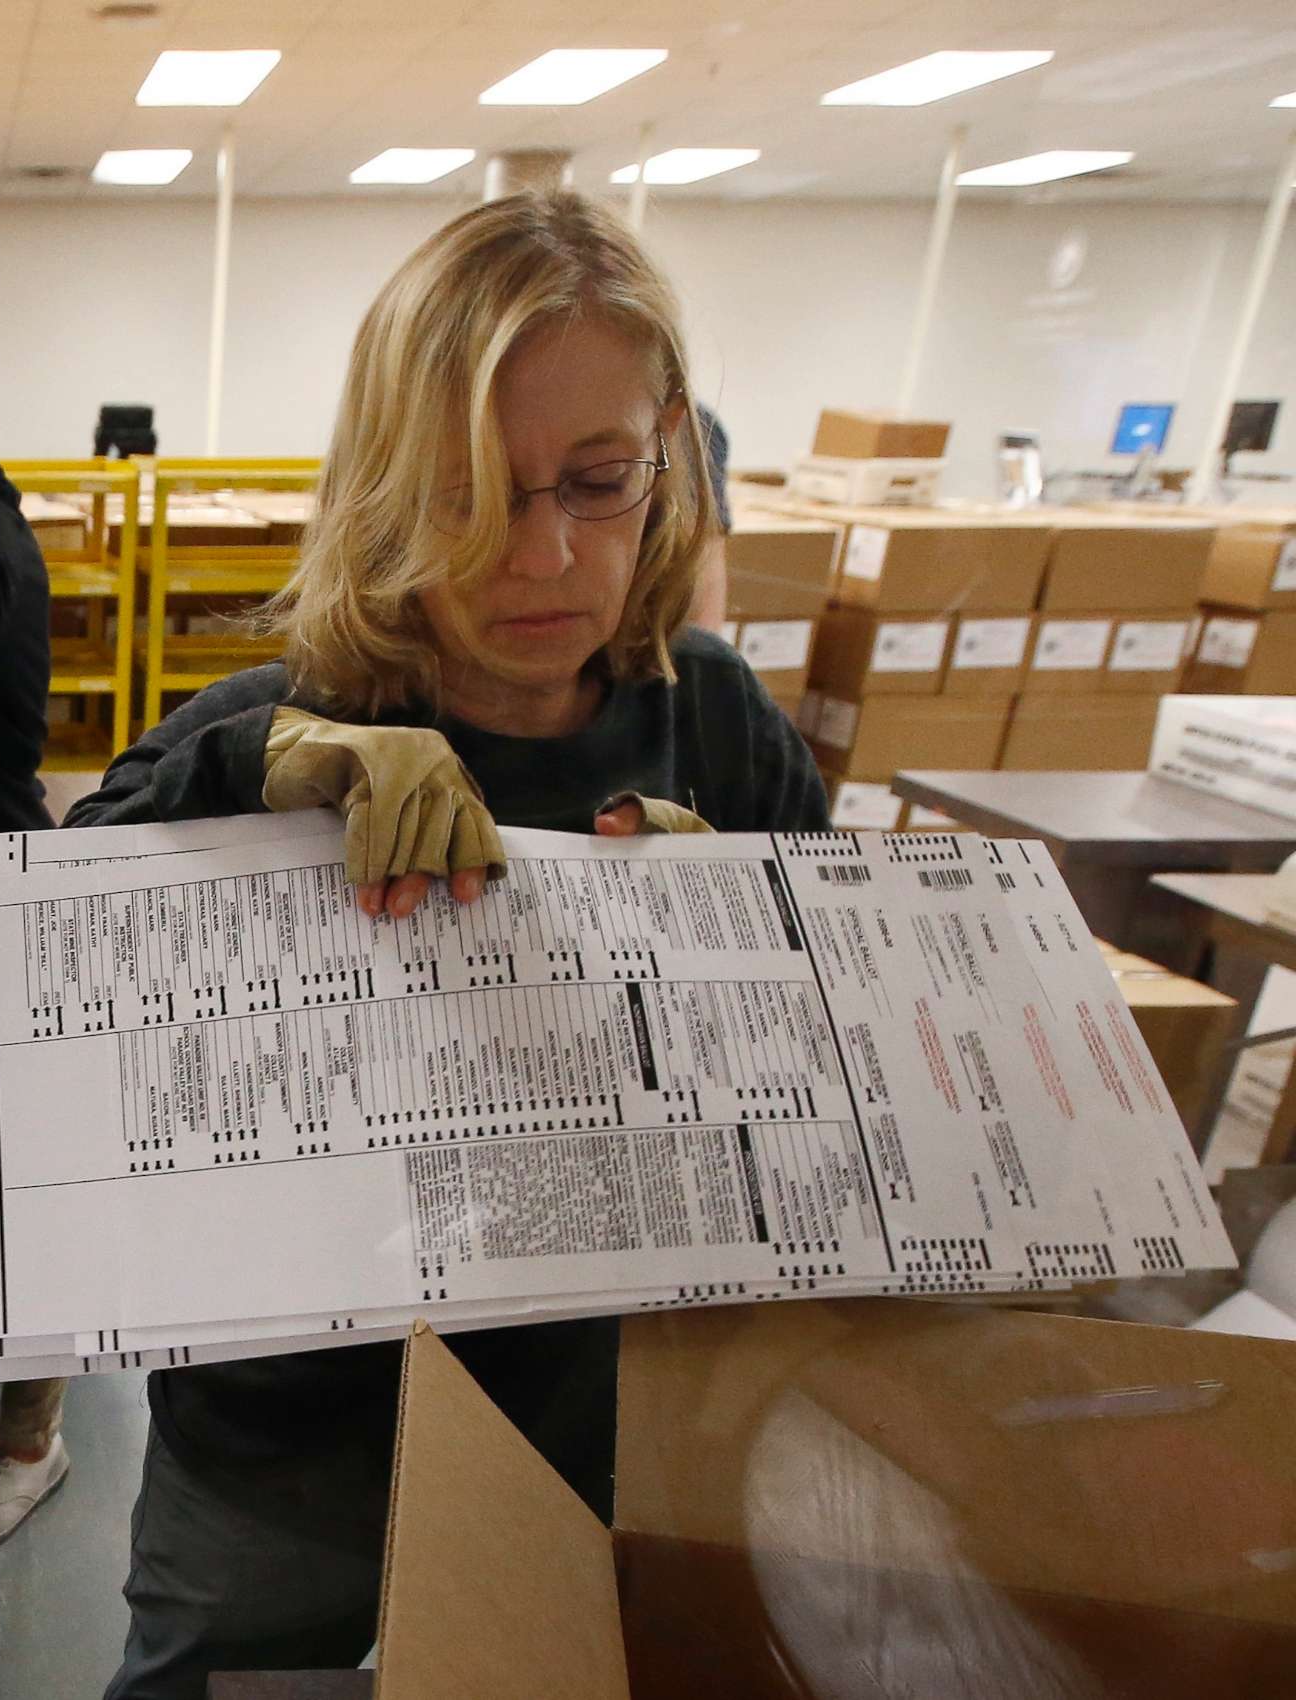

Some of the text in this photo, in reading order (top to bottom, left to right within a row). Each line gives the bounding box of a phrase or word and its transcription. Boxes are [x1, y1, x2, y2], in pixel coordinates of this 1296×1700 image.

[282, 892, 291, 924] SECRETARY
[119, 925, 127, 962] INSTRUCTION
[124, 904, 133, 953] SUPERINTENDENT
[229, 901, 239, 957] ATTORNEY GENERAL
[846, 906, 878, 979] OFFICIAL BALLOT
[178, 929, 186, 963] TREASURER
[949, 913, 984, 987] OFFICIAL BALLOT
[69, 950, 77, 982] INSPECTOR
[127, 962, 135, 982] PUBLIC
[176, 1036, 184, 1065] PARADISE
[193, 1034, 201, 1063] PARADISE
[339, 1046, 348, 1074] COLLEGE
[344, 1014, 358, 1105] MARICOPA COUNTY COMMUNITY
[184, 1050, 192, 1084] GOVERNING
[195, 1064, 203, 1086] VALLEY
[262, 1053, 271, 1080] DISTRICT
[270, 1054, 278, 1081] COLLEGE
[275, 1022, 287, 1113] MARICOPA COUNTY COMMUNITY
